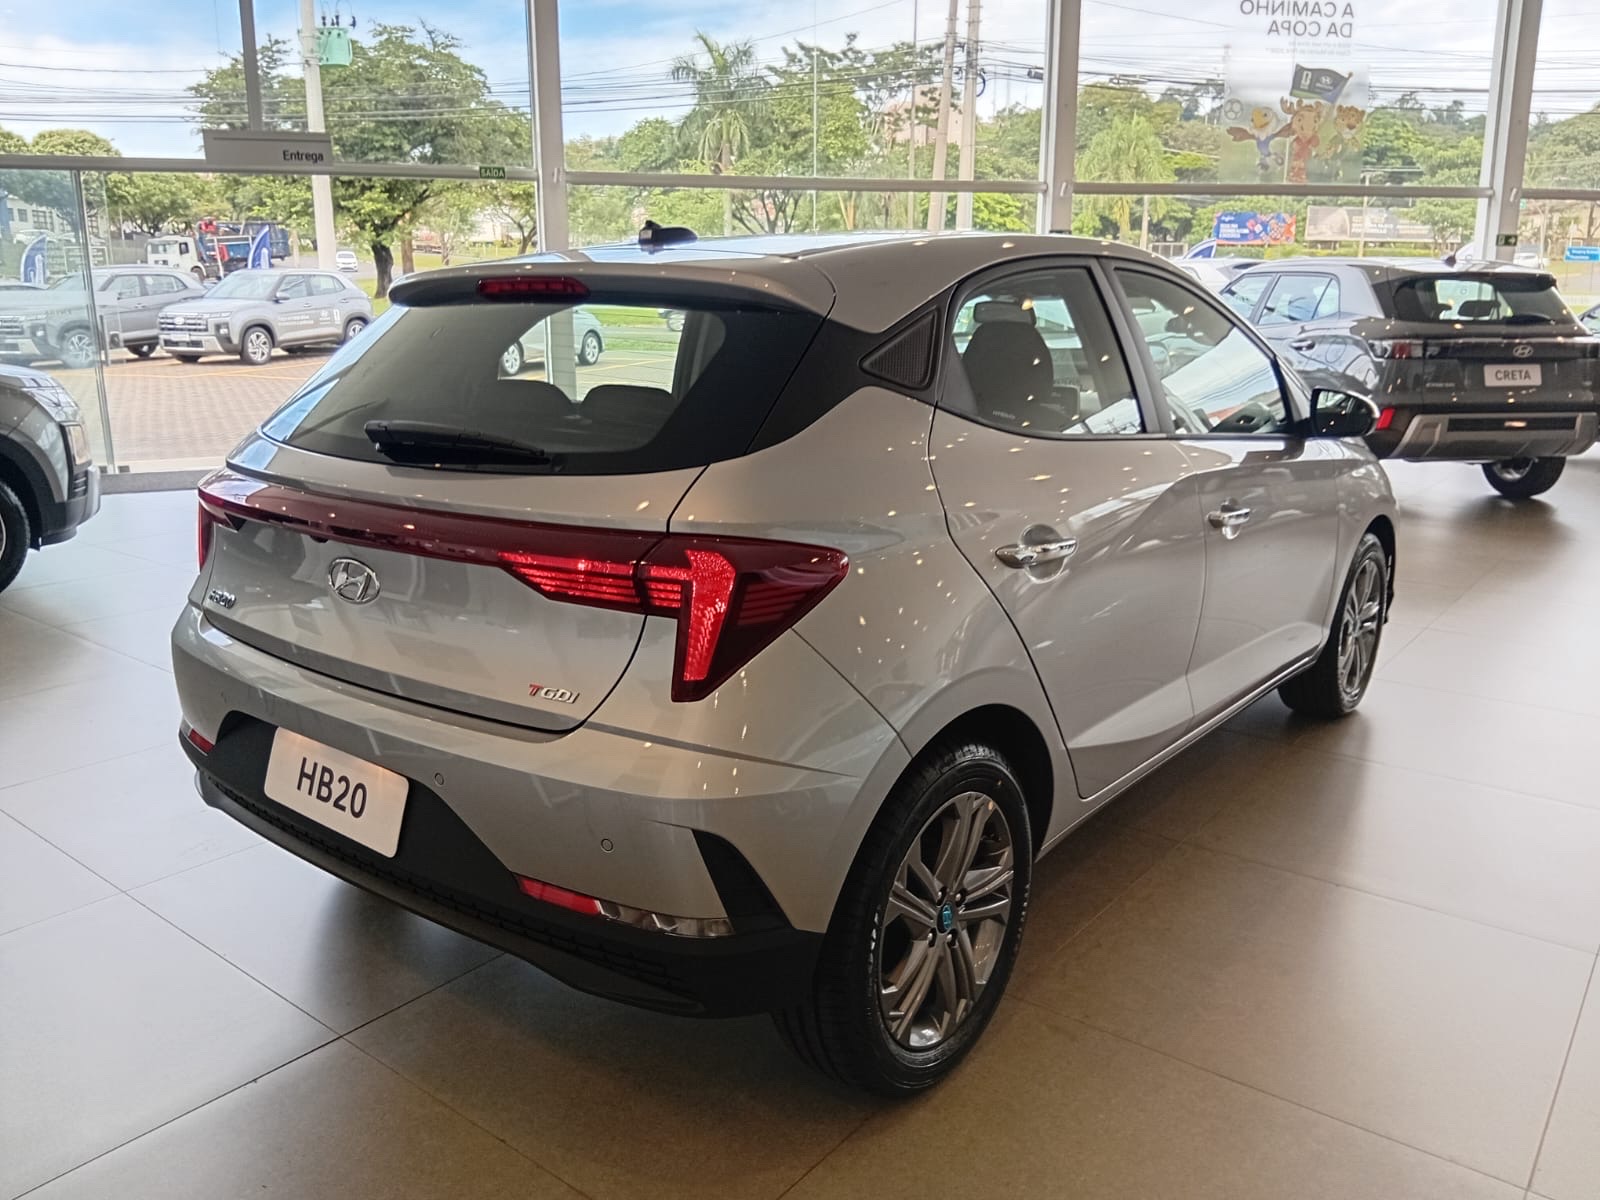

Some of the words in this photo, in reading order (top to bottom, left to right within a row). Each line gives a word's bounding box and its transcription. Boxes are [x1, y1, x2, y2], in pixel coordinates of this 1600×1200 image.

[282, 149, 324, 164] Entrega
[1494, 369, 1531, 382] CRETA
[296, 756, 367, 819] HB20
